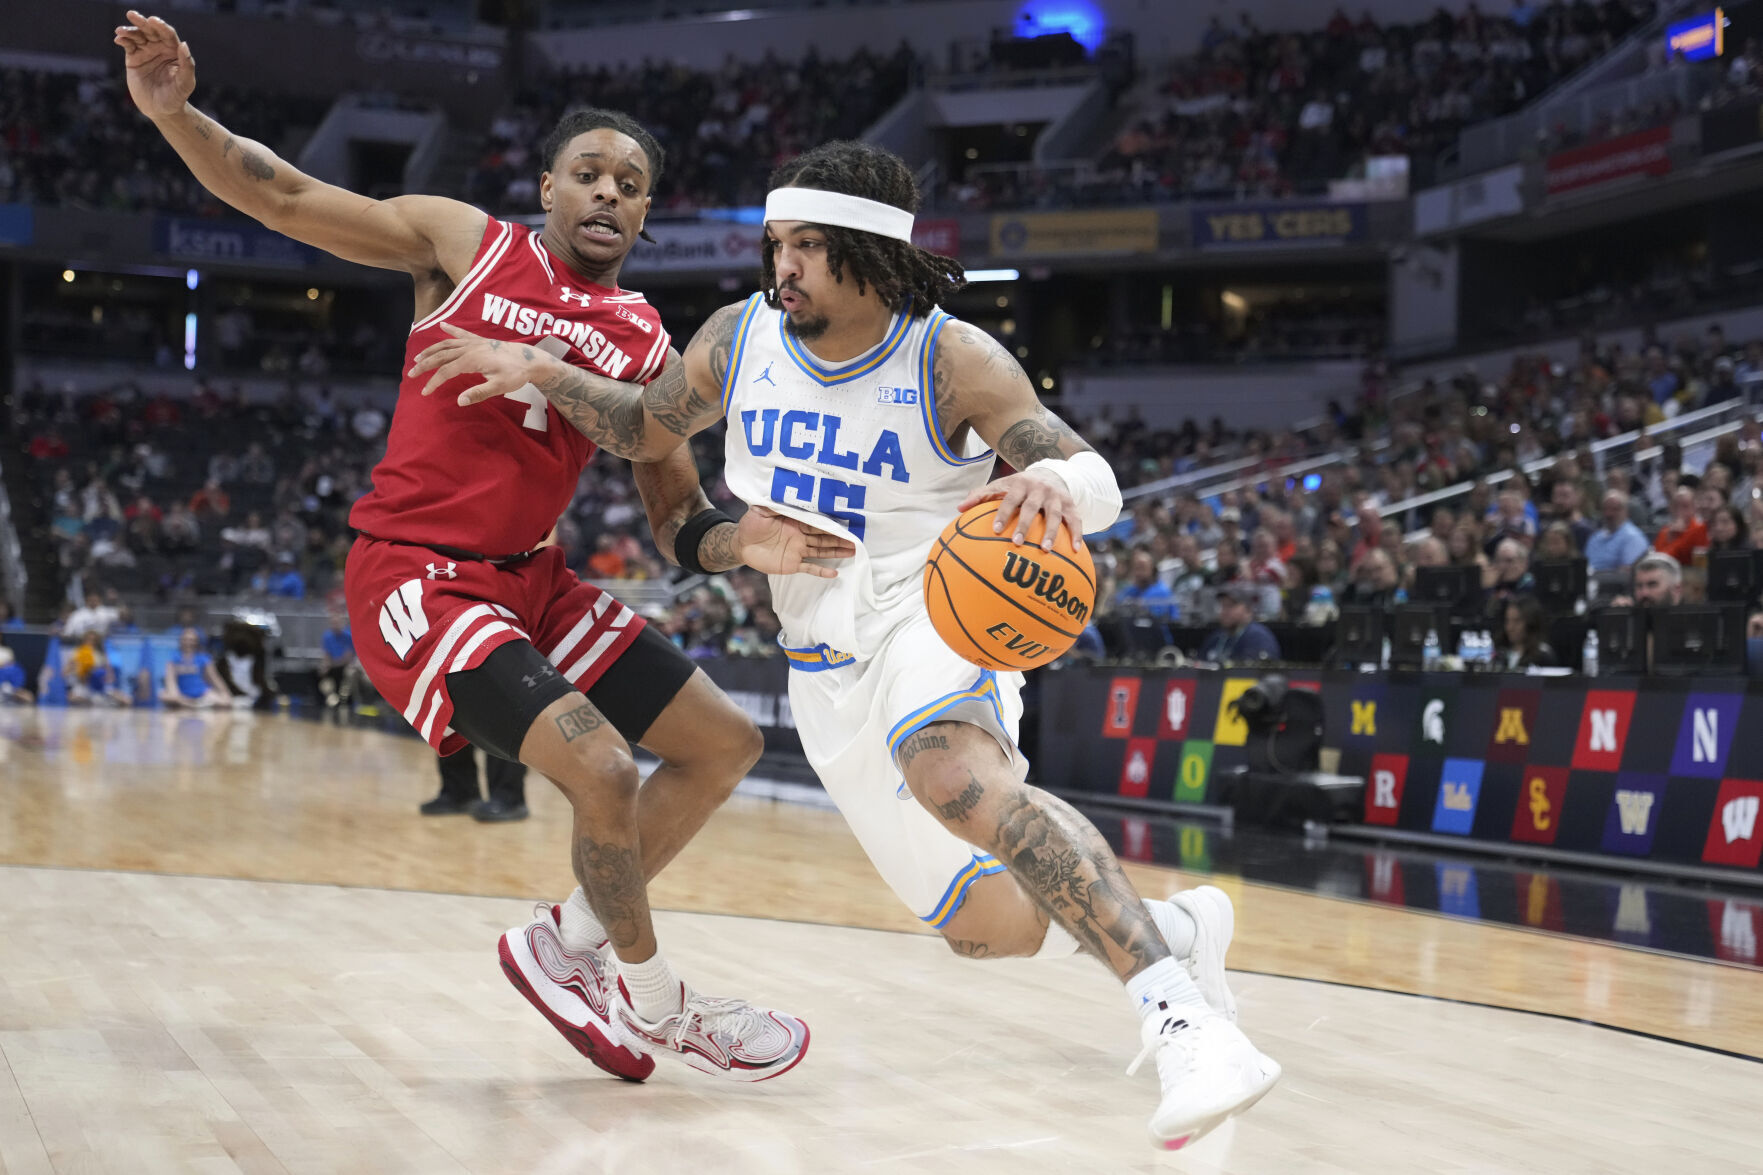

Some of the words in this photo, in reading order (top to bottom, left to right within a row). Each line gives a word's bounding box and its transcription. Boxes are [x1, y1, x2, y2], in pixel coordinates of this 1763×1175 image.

[170, 218, 244, 258] ksm
[1207, 213, 1264, 240] YES
[481, 292, 633, 379] WISCONSIN
[741, 409, 910, 483] UCLA
[1002, 550, 1089, 625] Wilson
[378, 578, 430, 663] W
[1351, 700, 1377, 736] M
[1590, 708, 1617, 752] N
[1693, 708, 1718, 763] N
[1374, 769, 1397, 809] R
[1615, 790, 1655, 835] W
[1722, 796, 1760, 844] W
